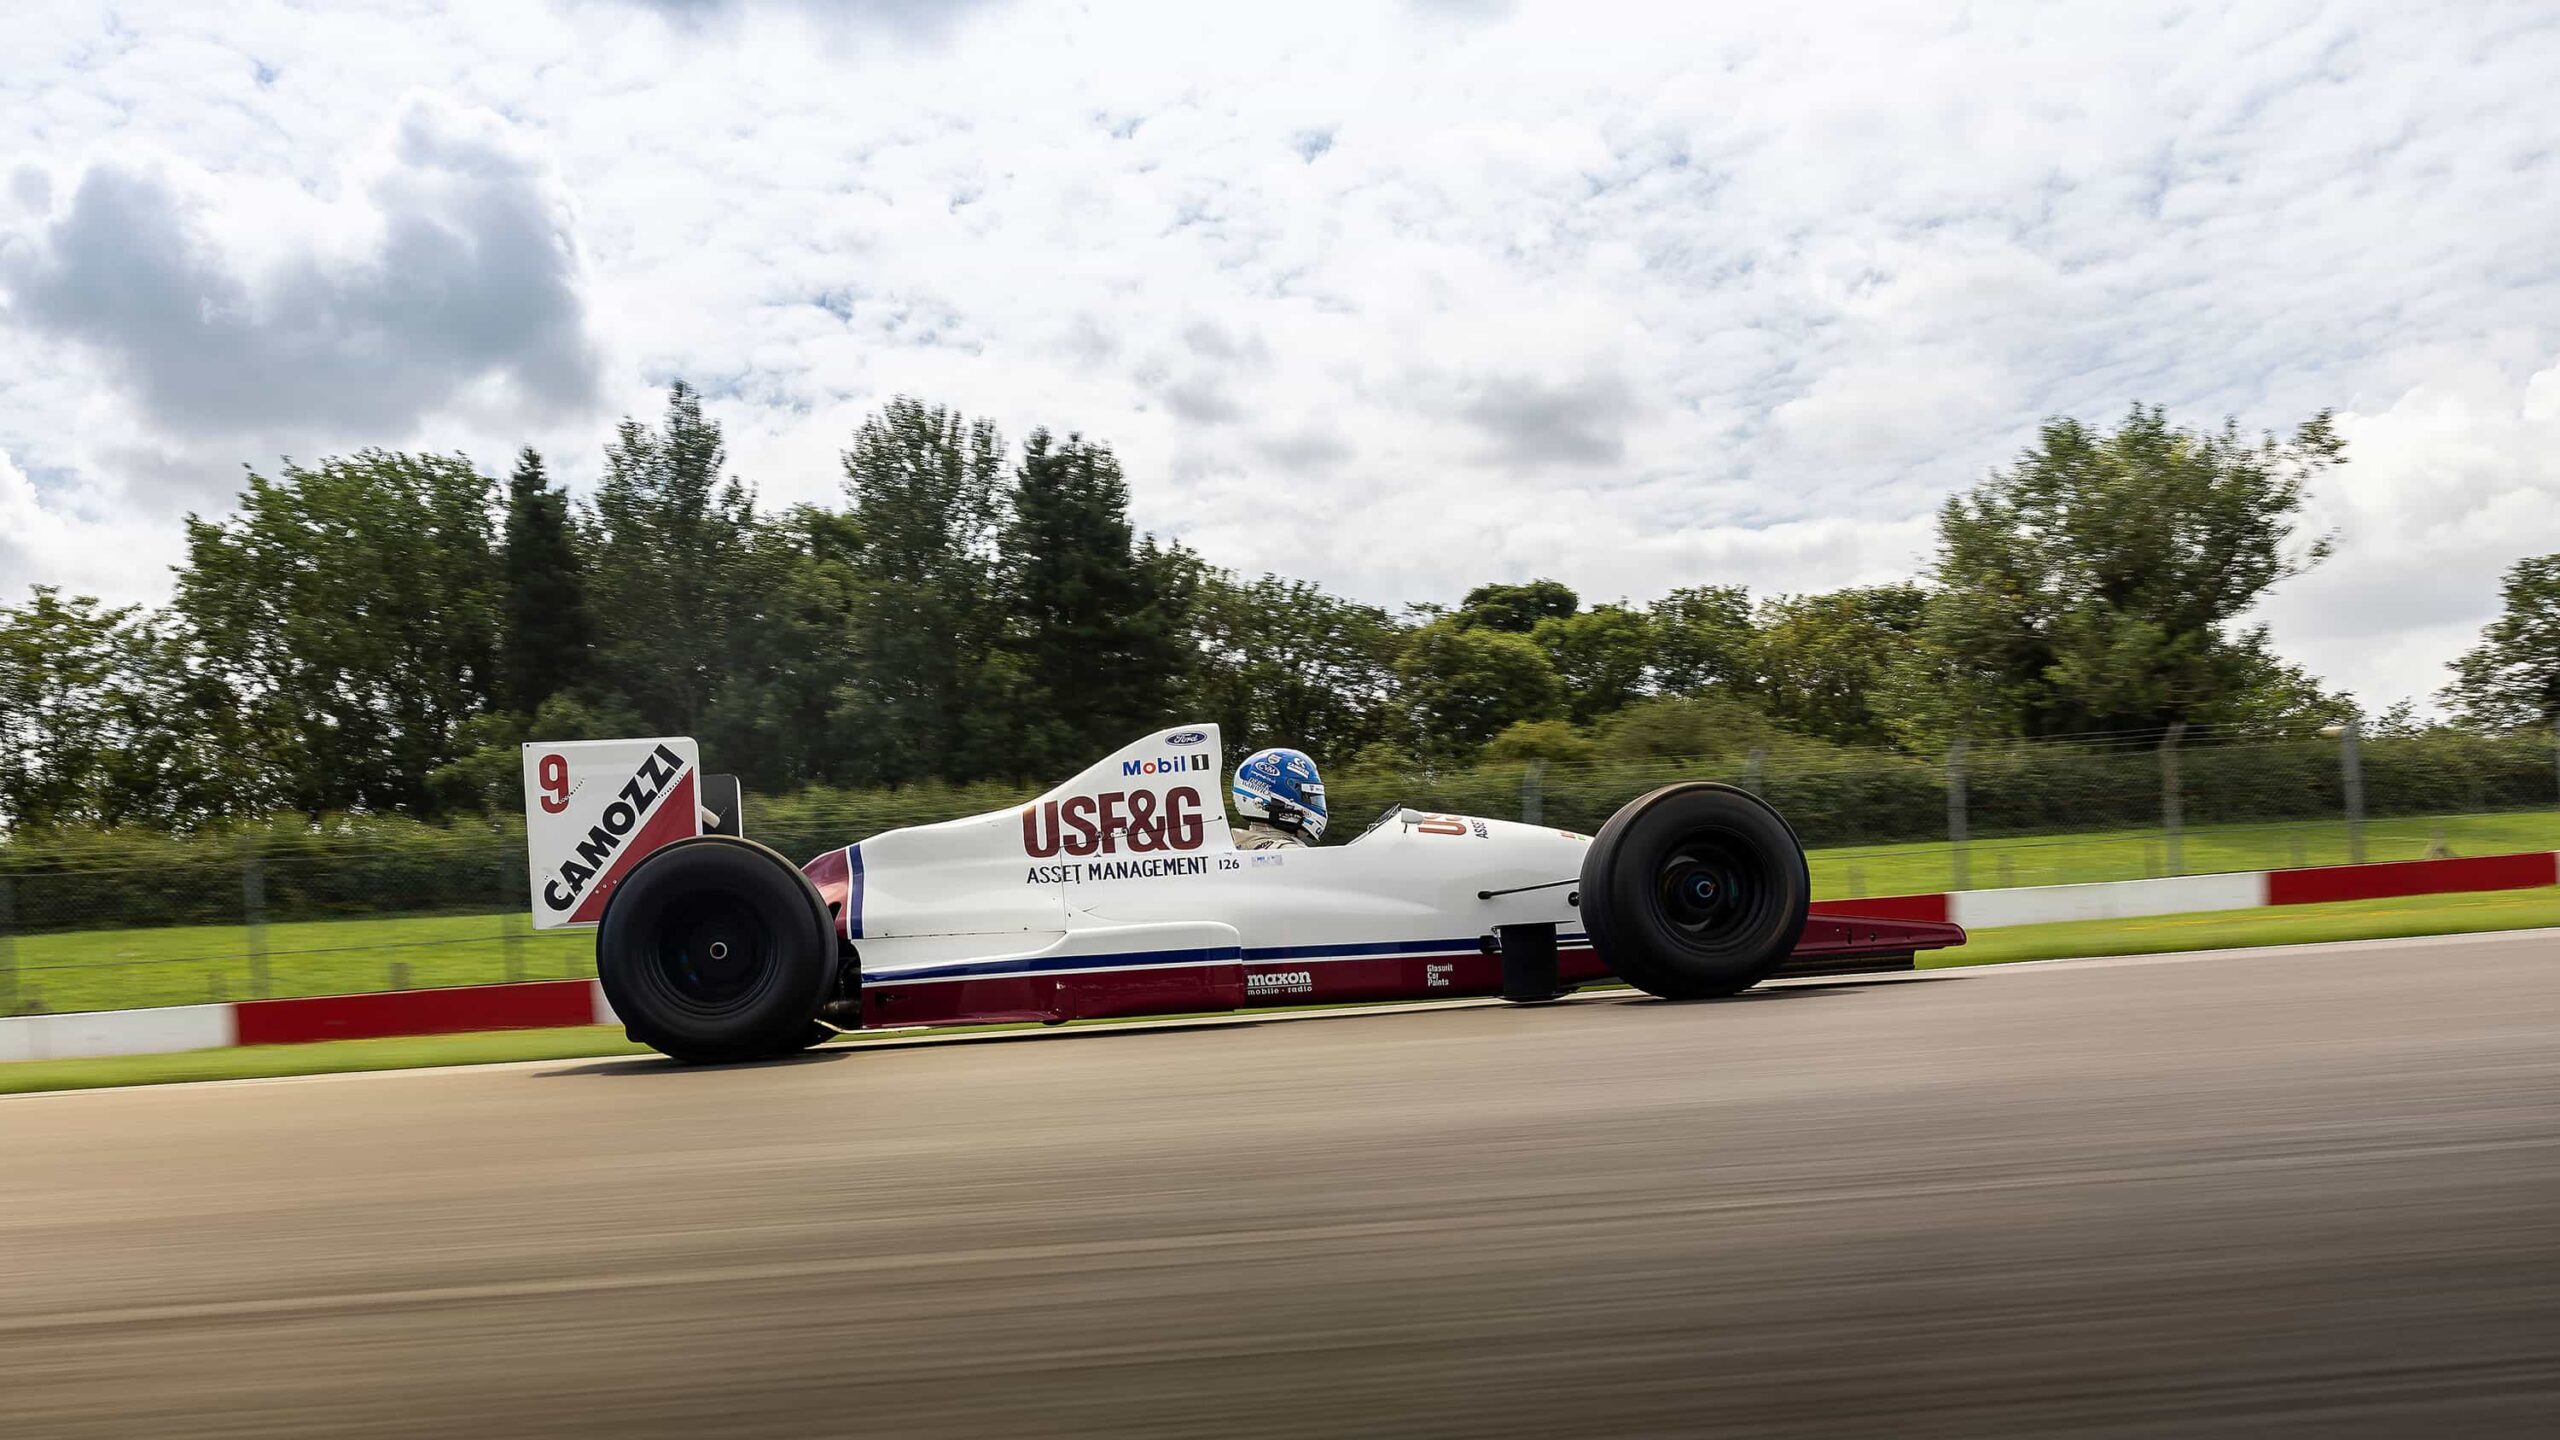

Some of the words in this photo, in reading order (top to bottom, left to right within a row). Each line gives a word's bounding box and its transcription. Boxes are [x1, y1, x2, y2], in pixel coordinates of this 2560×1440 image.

[1123, 756, 1186, 776] Mobil
[539, 754, 569, 814] 9
[544, 743, 684, 911] CAMOZZI
[1022, 786, 1204, 858] USF&G
[1027, 864, 1082, 884] ASSET
[1088, 856, 1209, 881] MANAGEMENT
[1219, 859, 1240, 870] 126
[1247, 971, 1311, 986] maxon
[1427, 978, 1449, 987] Paints
[1247, 987, 1280, 995] mobile
